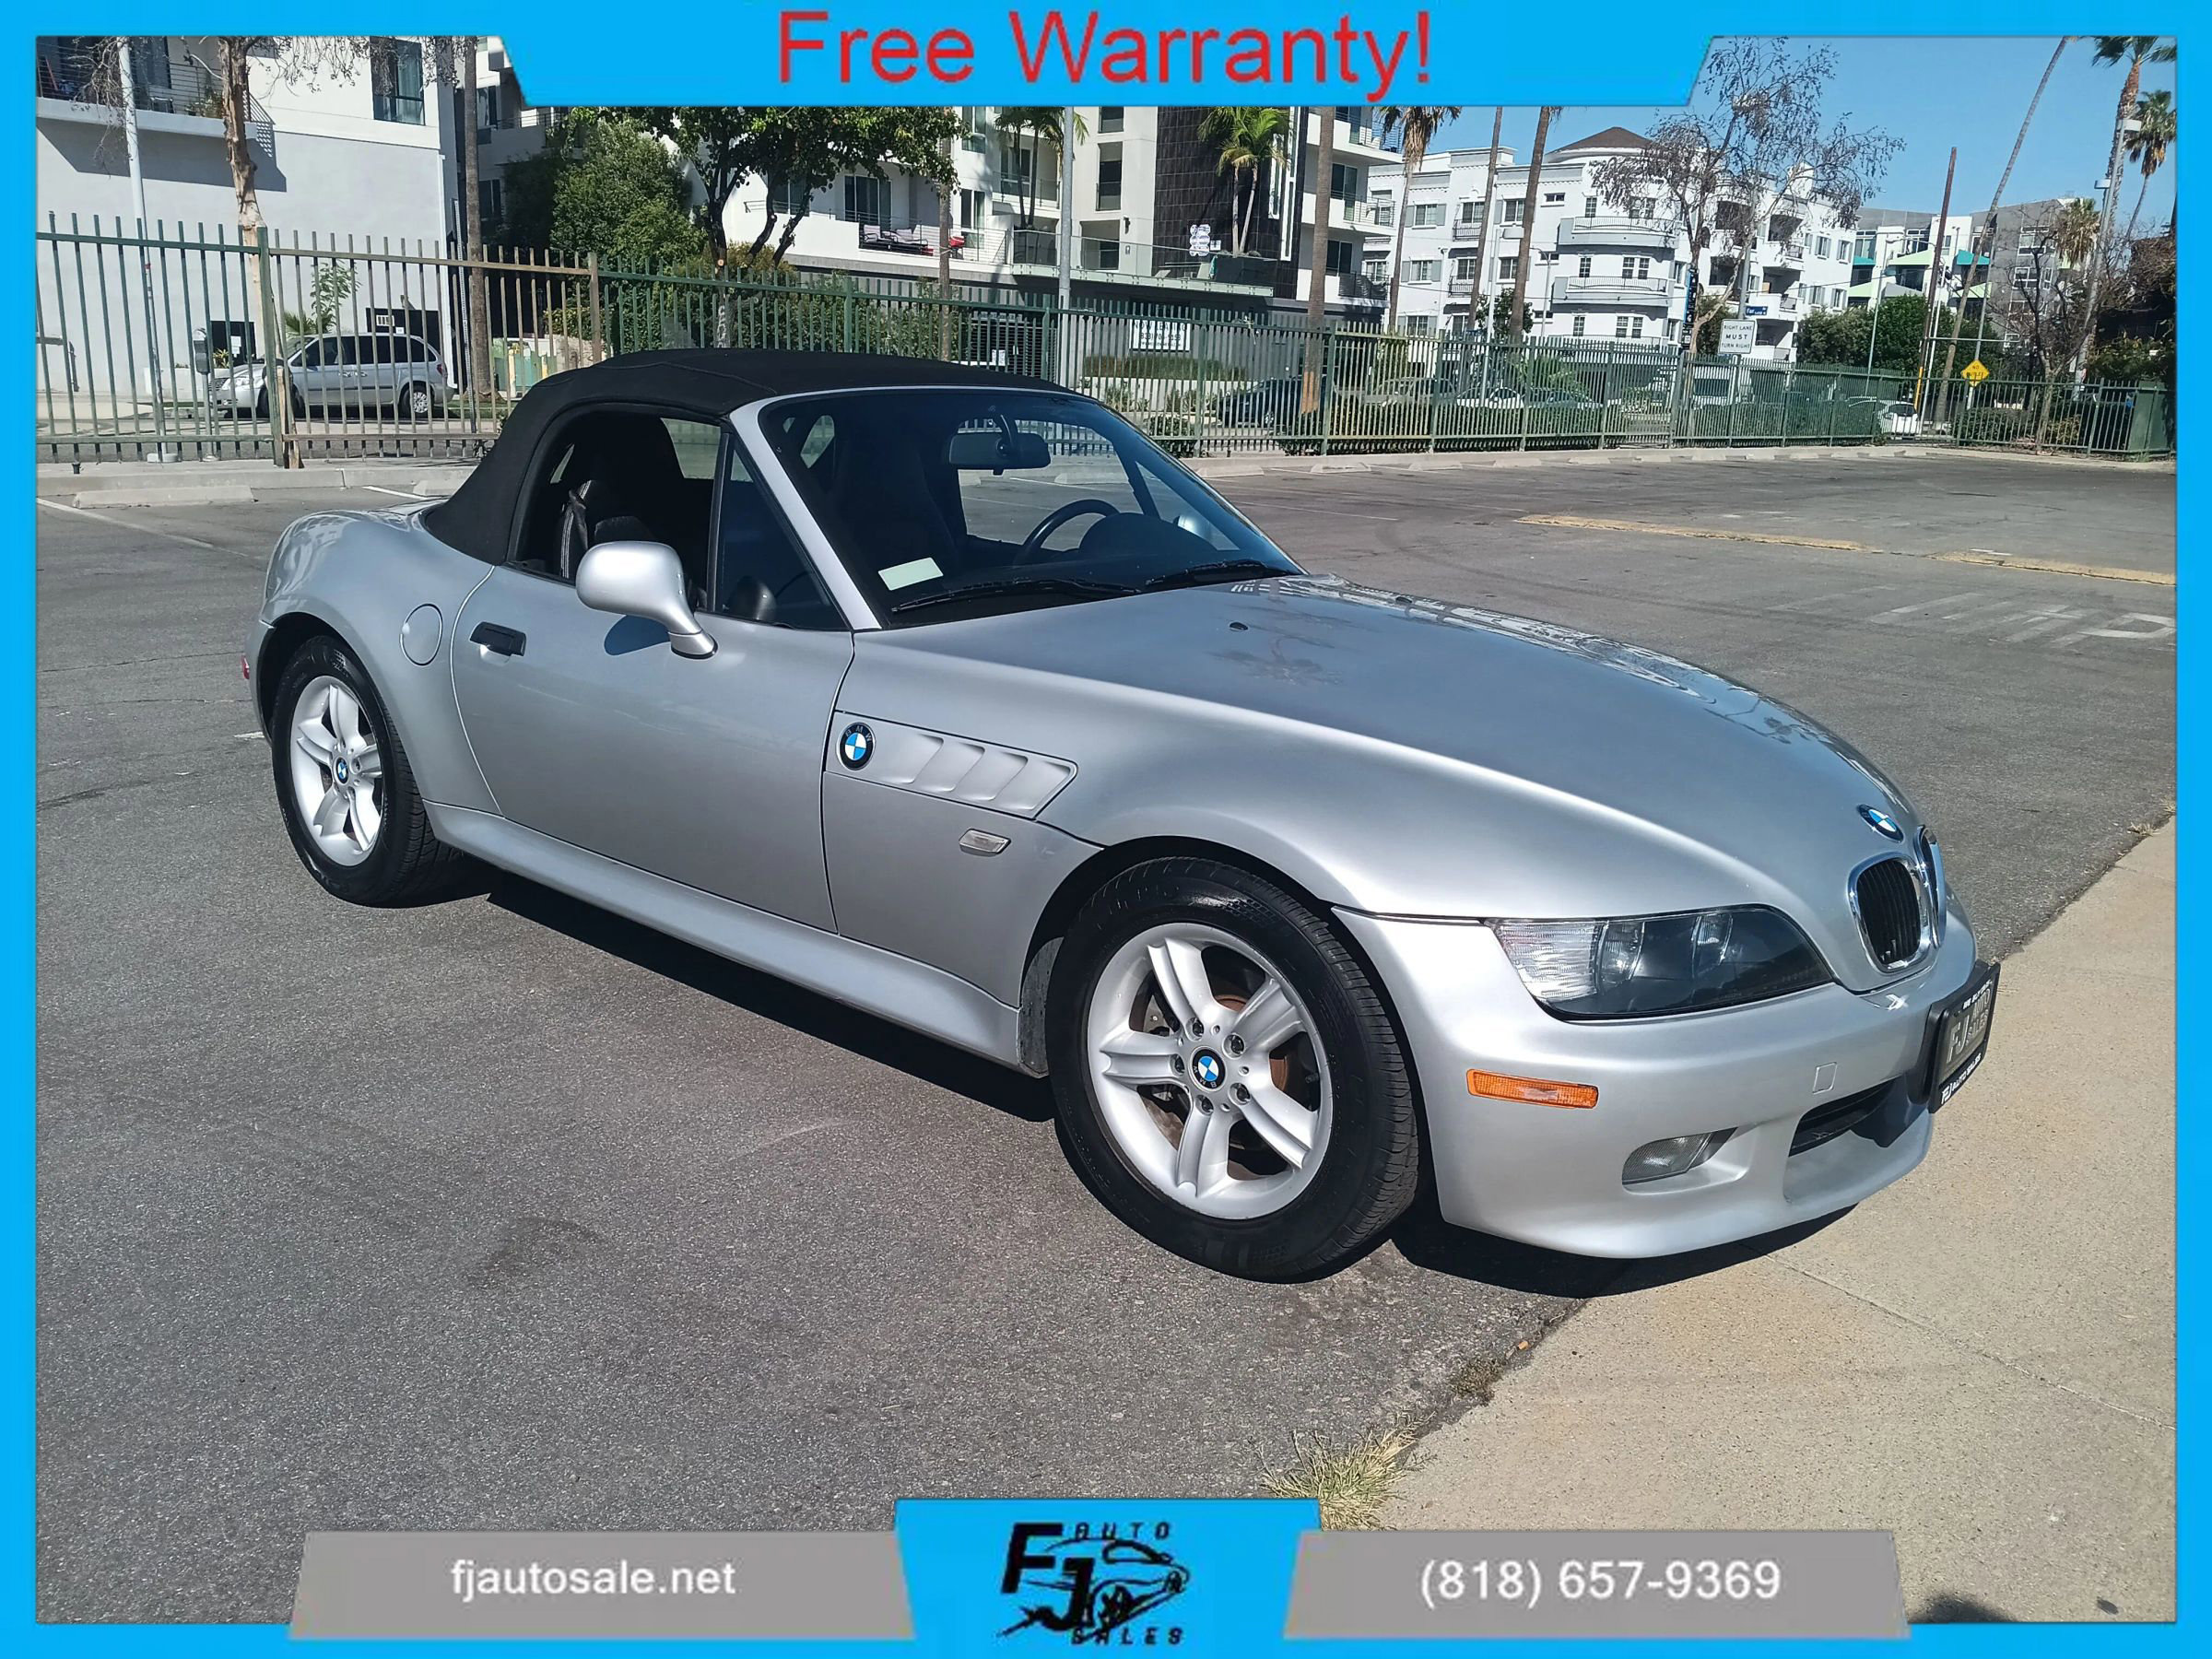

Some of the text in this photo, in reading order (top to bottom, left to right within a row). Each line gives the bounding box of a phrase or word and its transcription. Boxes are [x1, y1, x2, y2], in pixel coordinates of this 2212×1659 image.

[1946, 1015, 1970, 1065] FJ
[1941, 1082, 1953, 1105] FJ
[1951, 1070, 1967, 1092] AUTO
